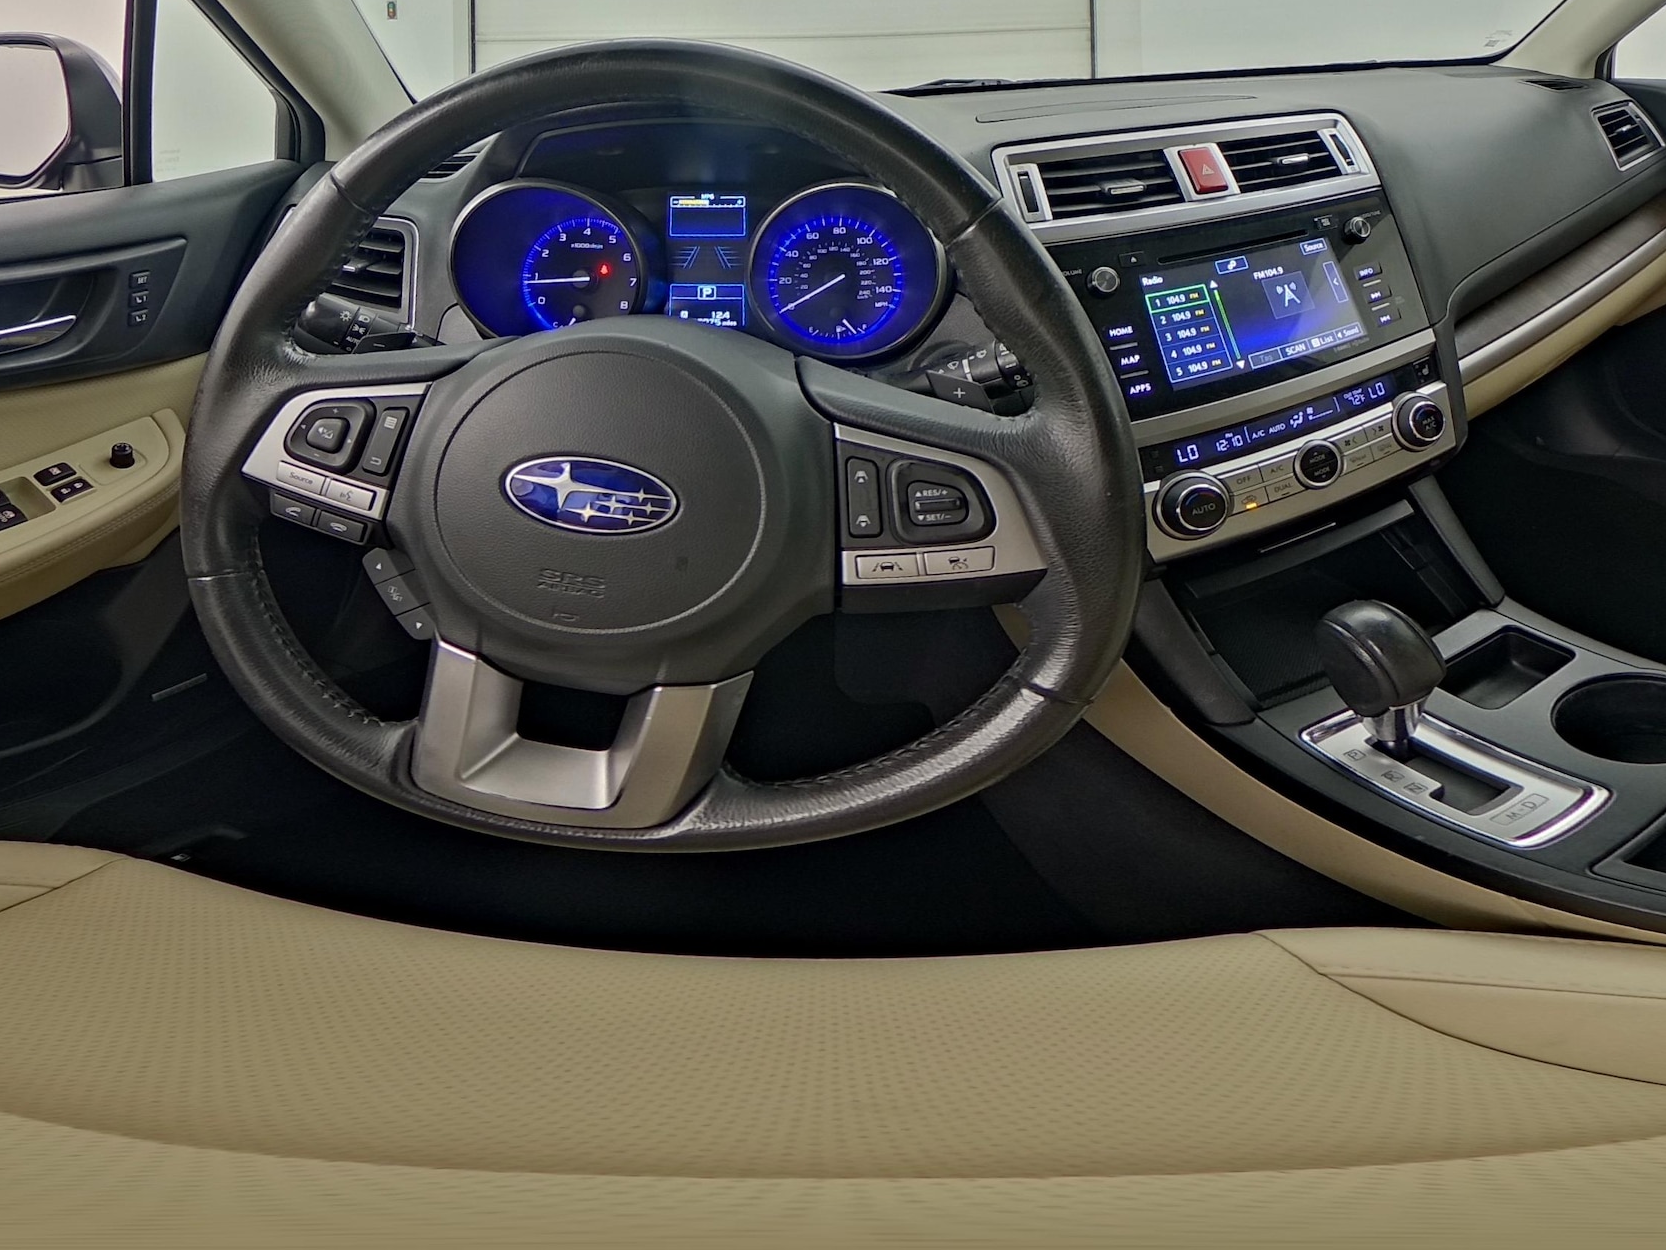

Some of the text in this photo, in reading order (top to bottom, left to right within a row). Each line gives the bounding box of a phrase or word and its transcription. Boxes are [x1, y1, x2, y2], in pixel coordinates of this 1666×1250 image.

[583, 227, 591, 236] 4
[806, 232, 819, 240] 60
[833, 227, 846, 235] 80
[559, 233, 567, 242] 3
[609, 235, 617, 244] 5
[857, 236, 873, 245] 100
[1304, 242, 1324, 252] Source
[542, 249, 549, 258] 2
[623, 253, 631, 262] 6
[785, 250, 799, 258] 40
[873, 257, 889, 266] 120
[629, 278, 637, 287] 7
[1142, 276, 1164, 287] Radio
[702, 288, 712, 298] P
[875, 285, 892, 294] 140
[537, 296, 546, 305] 0
[620, 301, 629, 309] 8
[1155, 299, 1161, 307] 1
[1166, 294, 1186, 305] 104.9
[711, 311, 731, 320] 124
[1160, 316, 1167, 324] 2
[1171, 311, 1191, 322] 104.9
[1108, 325, 1133, 338] HOME
[1165, 333, 1172, 342] 3
[1176, 328, 1197, 339] 104.9
[1285, 343, 1306, 356] SCAN
[1320, 335, 1334, 345] List
[1343, 325, 1359, 337] Sound
[1170, 350, 1178, 359] 4
[1182, 345, 1202, 356] 104.9
[1120, 354, 1140, 366] MAP
[1176, 367, 1183, 376] 5
[1187, 362, 1208, 373] 104.9
[1129, 382, 1152, 395] APPS
[1252, 430, 1265, 439] A/C
[1268, 423, 1286, 434] AUTO
[1309, 453, 1326, 464] MODE
[1236, 464, 1284, 485] OFF A/C
[1313, 466, 1331, 477] MODE
[289, 471, 314, 485] Source
[1274, 482, 1292, 493] DUAL
[1192, 503, 1216, 516] AUTO
